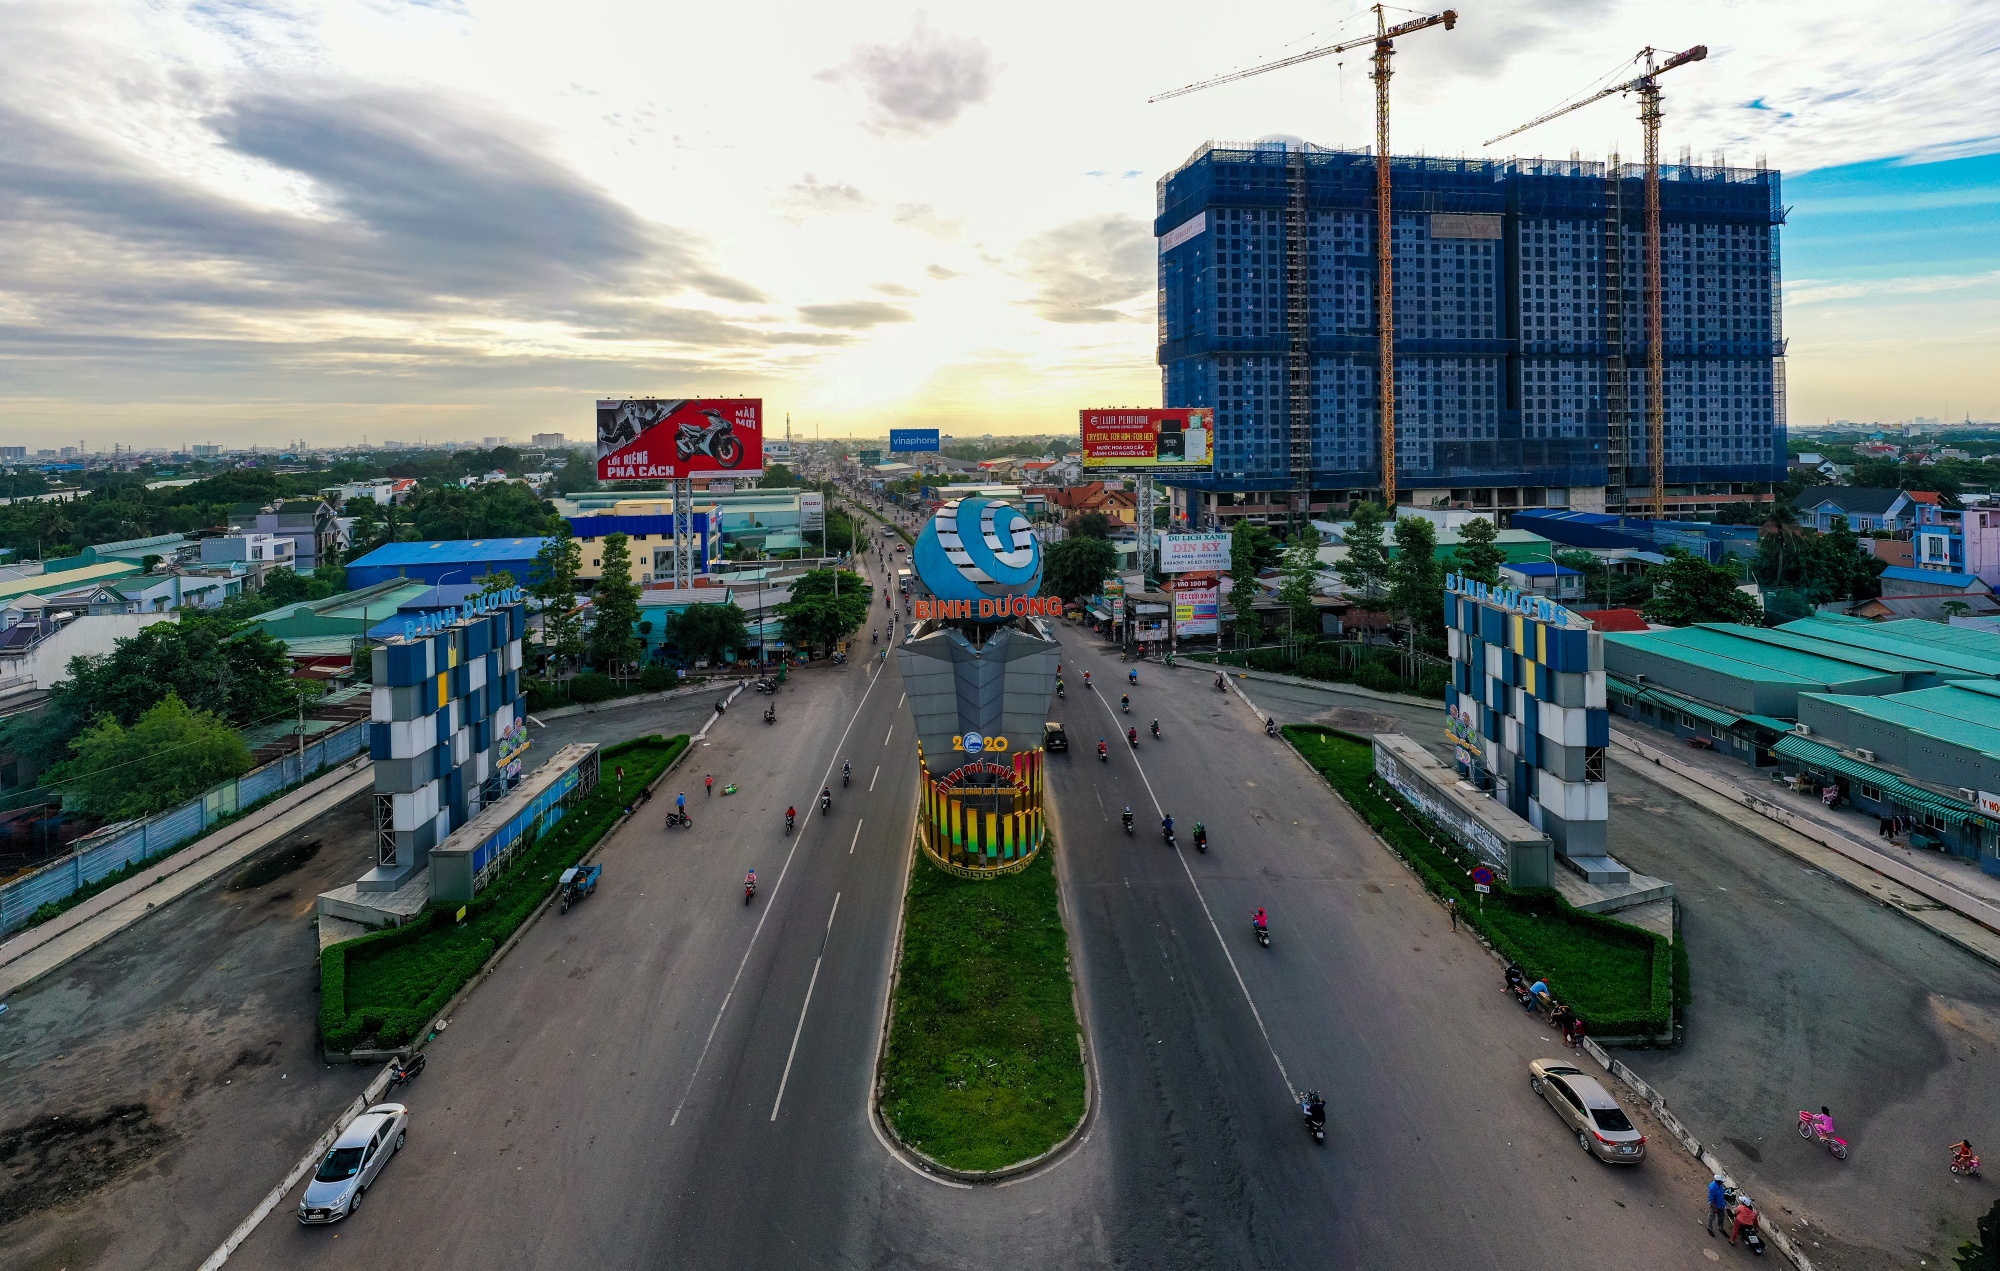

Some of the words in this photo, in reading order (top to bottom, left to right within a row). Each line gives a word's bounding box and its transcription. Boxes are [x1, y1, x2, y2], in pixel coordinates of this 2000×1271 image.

[1387, 24, 1401, 34] KHC
[1403, 16, 1427, 29] GROUP
[735, 406, 755, 419] MÀU
[735, 418, 756, 430] MỚI
[1118, 415, 1149, 425] PERFUME
[893, 436, 938, 446] vinaphone
[1086, 432, 1109, 442] CRYSTAL
[1110, 432, 1121, 441] FOR
[1143, 432, 1154, 441] HER
[607, 454, 621, 466] LỐI
[624, 451, 648, 465] RIÊNG
[1136, 449, 1149, 457] VIỆT
[607, 464, 636, 478] PHÁ
[638, 463, 675, 477] CÁCH
[1182, 534, 1202, 543] LỊCH
[1446, 567, 1488, 601] BÌNH
[1492, 585, 1568, 628] DƯƠNG
[914, 594, 971, 619] BÌNH
[979, 593, 1063, 618] DƯƠNG
[403, 606, 457, 642] BÌNH
[462, 584, 521, 620] DƯƠNG
[935, 767, 965, 795] THÀNH
[964, 757, 984, 775] PHỐ
[986, 762, 1018, 784] THUẬN
[1014, 779, 1031, 794] AN
[1981, 798, 1987, 808] Y
